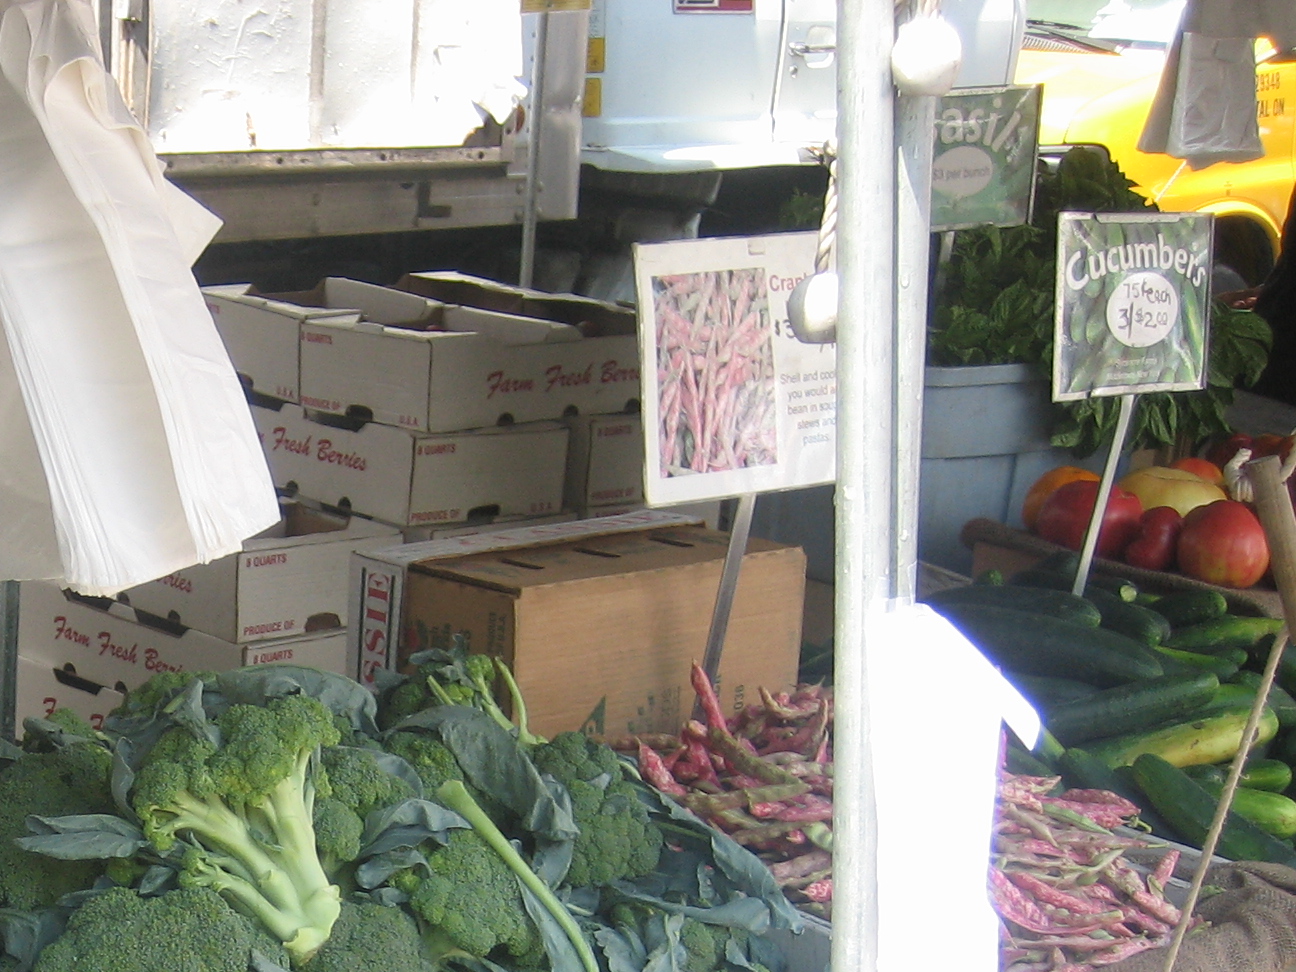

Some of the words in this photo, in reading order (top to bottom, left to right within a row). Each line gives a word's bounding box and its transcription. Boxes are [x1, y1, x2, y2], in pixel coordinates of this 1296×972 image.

[933, 97, 1022, 153] asil
[1066, 233, 1207, 290] Cucumbers
[769, 273, 806, 292] Cran
[487, 370, 535, 399] Farm
[545, 362, 595, 392] Fresh
[803, 371, 818, 382] and
[820, 371, 836, 380] coo
[787, 391, 802, 401] you
[805, 387, 828, 397] would
[787, 404, 809, 415] bean
[810, 403, 817, 413] in
[819, 402, 836, 413] sou
[273, 426, 312, 456] Fresh
[317, 438, 366, 471] Berries
[423, 443, 456, 455] QUARTS
[254, 553, 288, 567] QUARTS
[243, 622, 282, 636] PRODUCE
[283, 620, 295, 631] OF
[54, 616, 90, 648] Farm
[98, 632, 138, 665] Fresh
[260, 649, 293, 663] QUARTS
